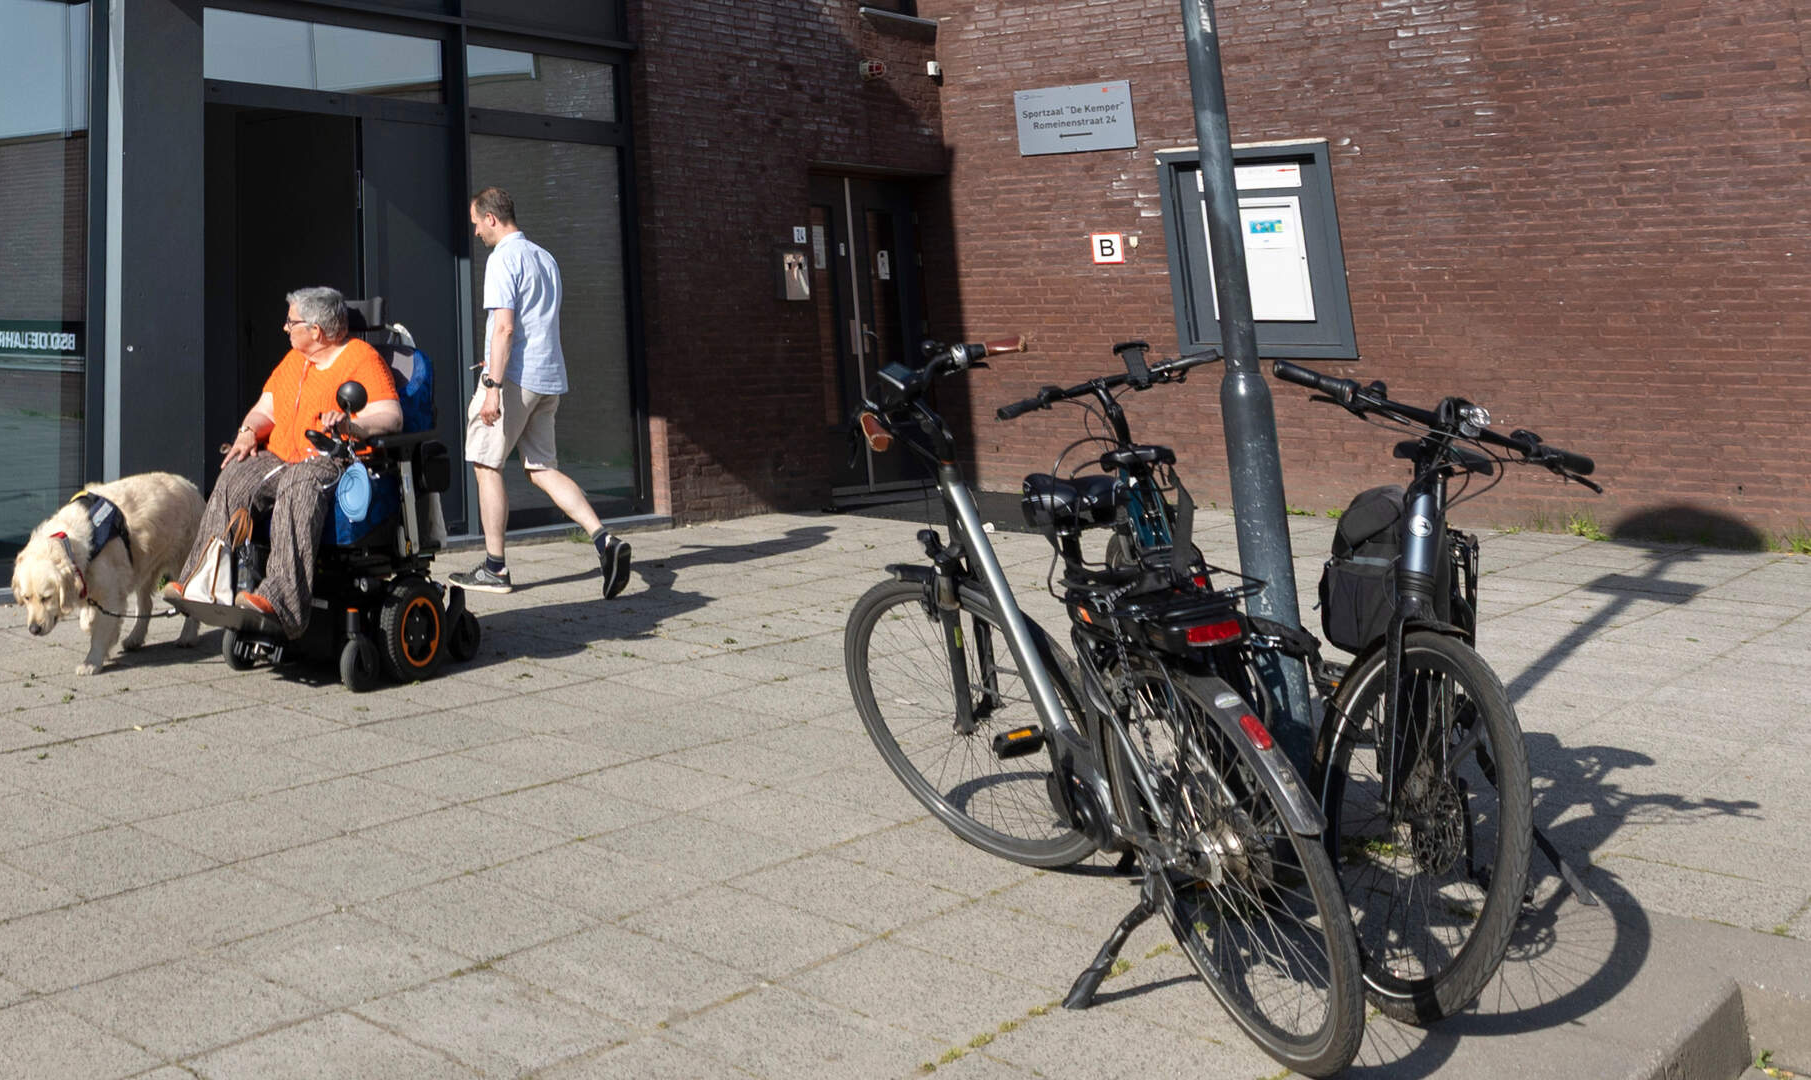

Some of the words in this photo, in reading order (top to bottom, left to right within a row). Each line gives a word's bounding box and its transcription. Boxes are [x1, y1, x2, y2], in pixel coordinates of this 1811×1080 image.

[1022, 107, 1064, 119] Sportzaal
[1033, 116, 1104, 130] Romeinenstraat
[1105, 115, 1117, 124] 24
[1099, 239, 1115, 257] B
